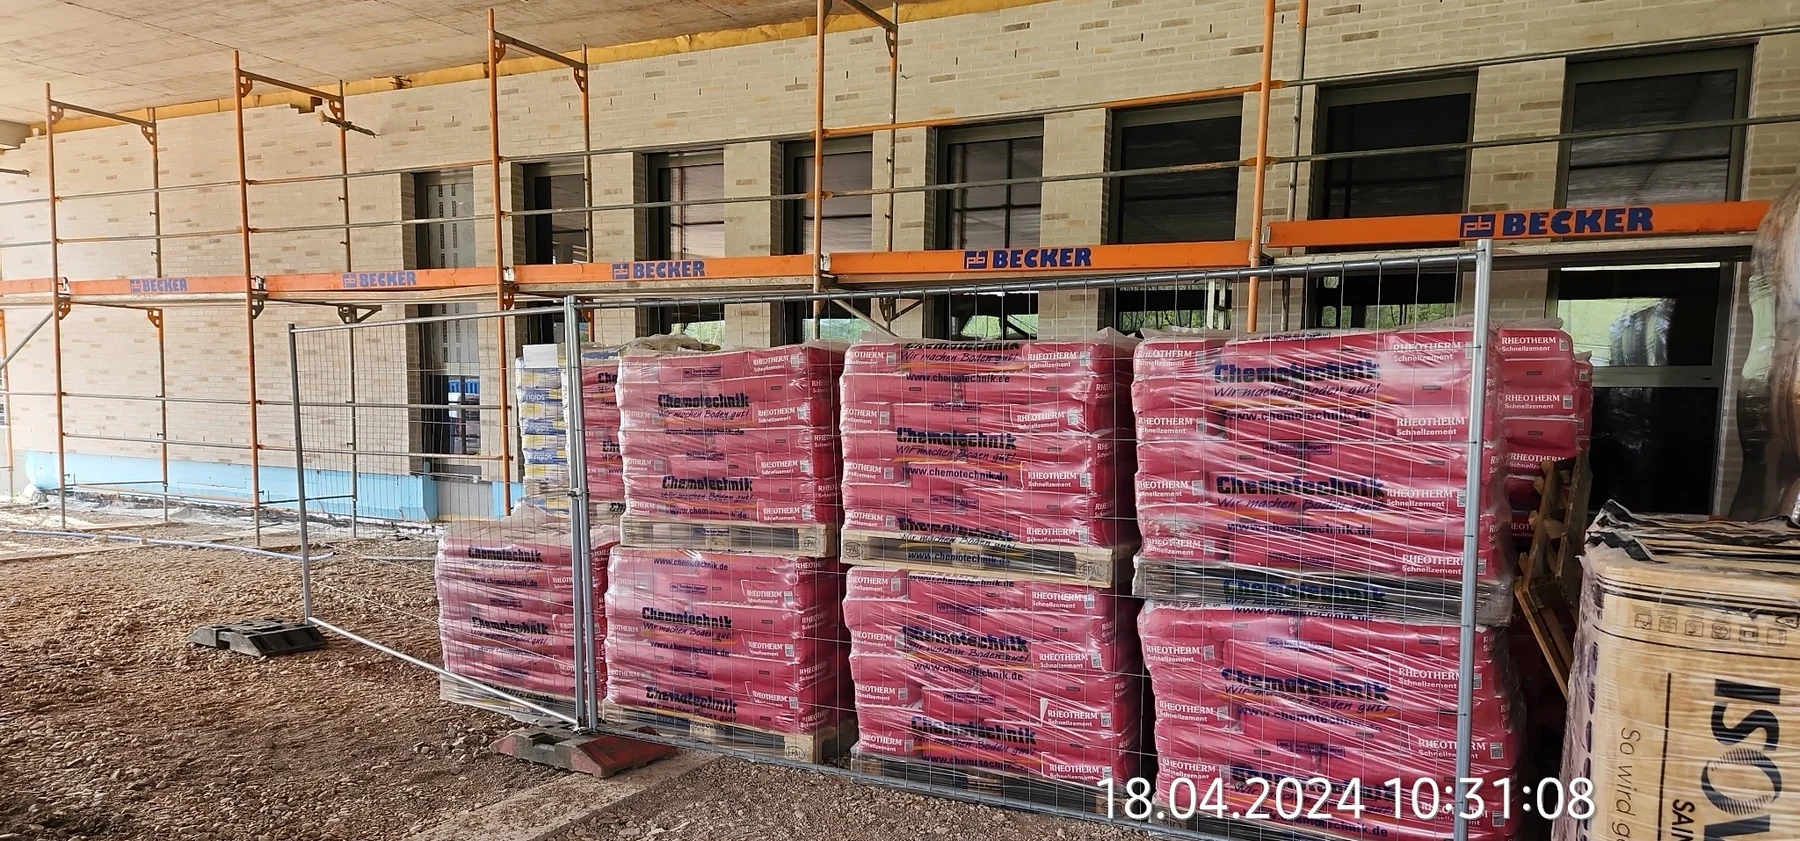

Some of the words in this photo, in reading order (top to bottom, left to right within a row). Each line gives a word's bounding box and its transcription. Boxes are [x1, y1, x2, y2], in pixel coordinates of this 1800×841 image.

[1502, 207, 1653, 237] BECKER
[993, 247, 1093, 269] BECKER
[633, 260, 705, 279] BECKER
[360, 271, 417, 288] BECKER
[144, 278, 188, 292] BECKER
[1502, 336, 1556, 346] RHEOTHERM
[1501, 346, 1551, 354] Schnellzement
[1027, 351, 1077, 361] RHEOTHERM
[906, 373, 1011, 383] www.chemotechnik.de
[1214, 386, 1240, 398] Wir
[1505, 394, 1560, 403] RHEOTHERM
[1504, 403, 1554, 411] Schnellzement
[1396, 417, 1465, 427] RHEOTHERM
[1396, 429, 1457, 437] Schnellzement
[903, 466, 1008, 481] www.chemotechnik.de
[1028, 471, 1077, 481] RHEOTHERM
[1386, 488, 1453, 498] RHEOTHERM
[1246, 498, 1297, 510] machen
[1386, 501, 1445, 509] Schnellzement
[1402, 566, 1462, 576] Schnellzement
[1032, 591, 1082, 602] RHEOTHERM
[1146, 644, 1201, 655] RHEOTHERM
[1039, 652, 1088, 662] RHEOTHERM
[1159, 701, 1214, 714] RHEOTHERM
[1047, 709, 1098, 720] RHEOTHERM
[1619, 727, 1641, 755] So
[1049, 763, 1099, 773] RHEOTHERM
[1615, 764, 1637, 816] wird
